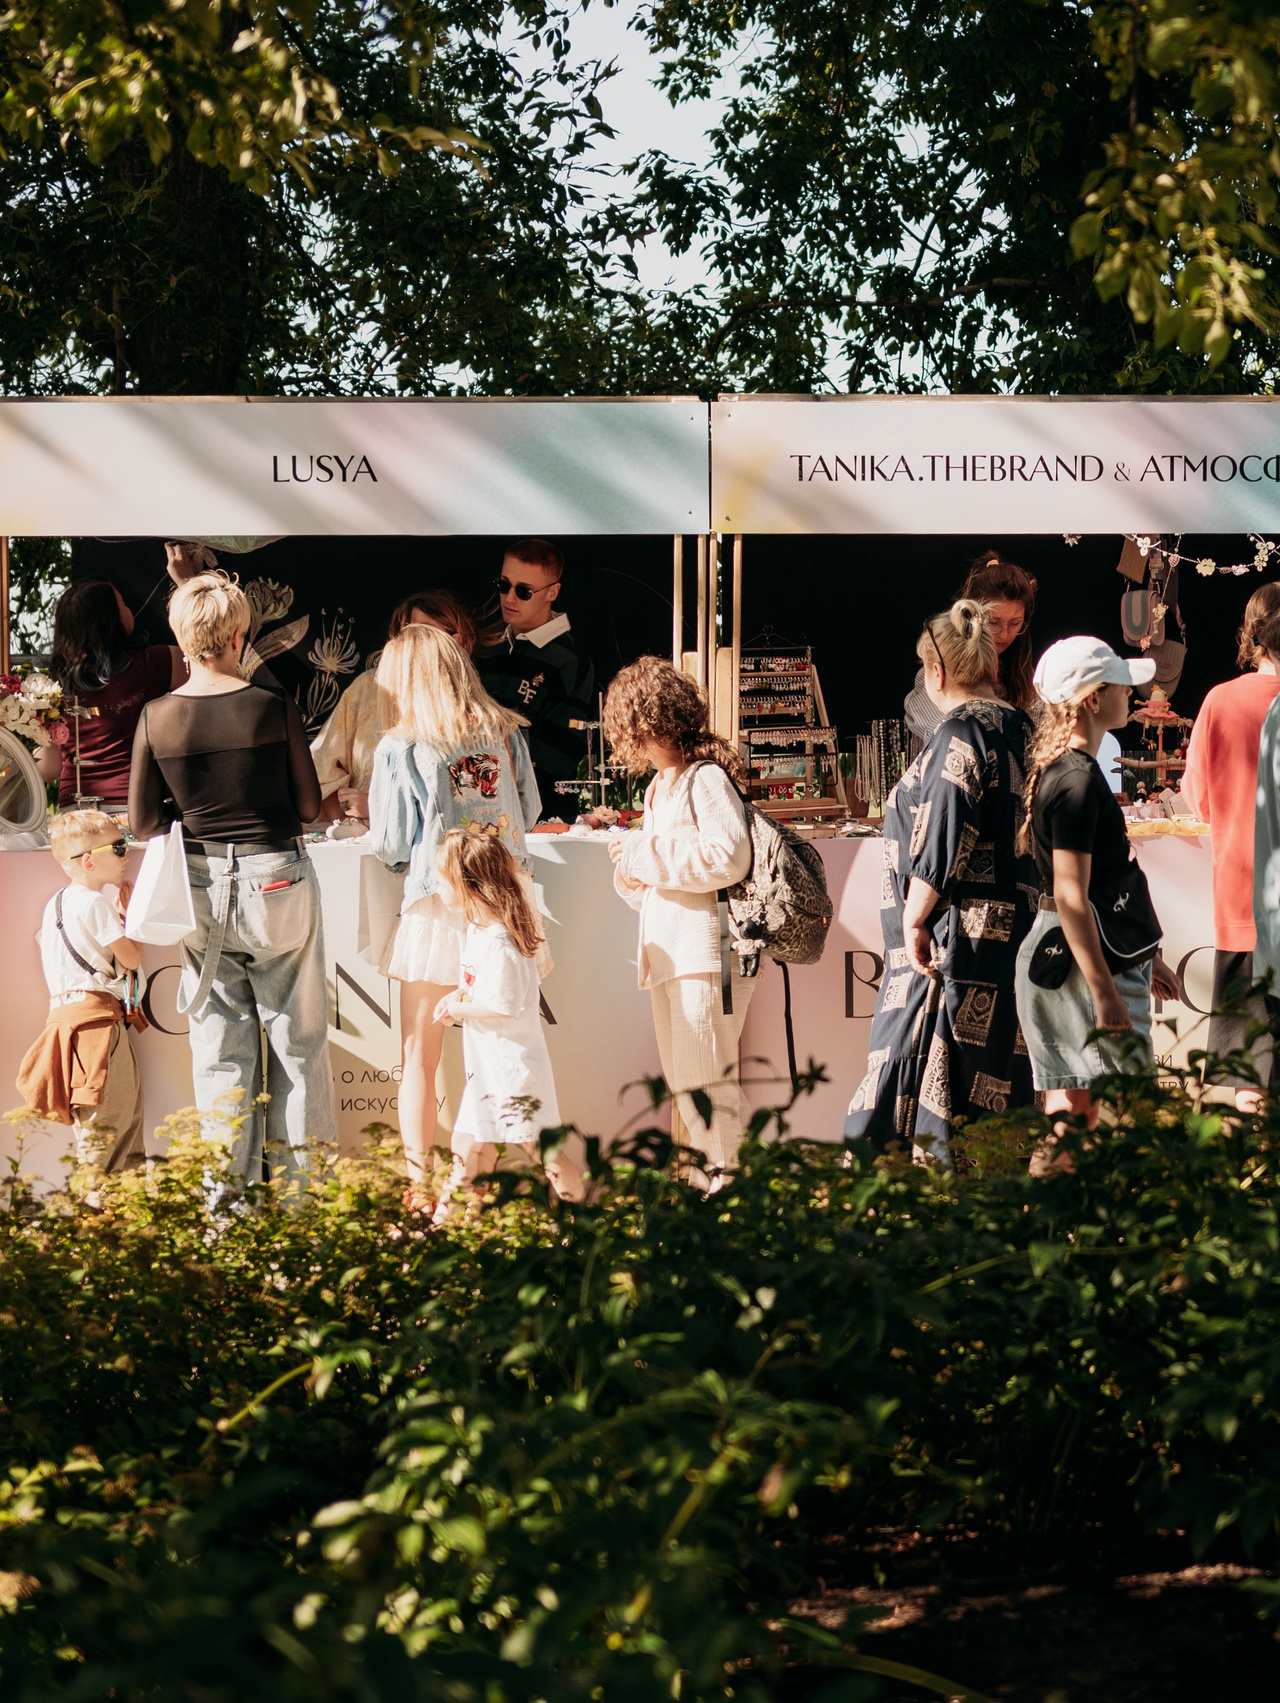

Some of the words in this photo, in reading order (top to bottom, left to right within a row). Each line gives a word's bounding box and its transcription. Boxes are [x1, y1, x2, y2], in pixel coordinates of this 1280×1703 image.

[272, 455, 379, 483] LUSYA
[789, 454, 1105, 483] TANIKA.THEBRAND
[1113, 460, 1131, 482] &
[341, 1070, 354, 1084] о
[341, 1096, 446, 1113] искусу
